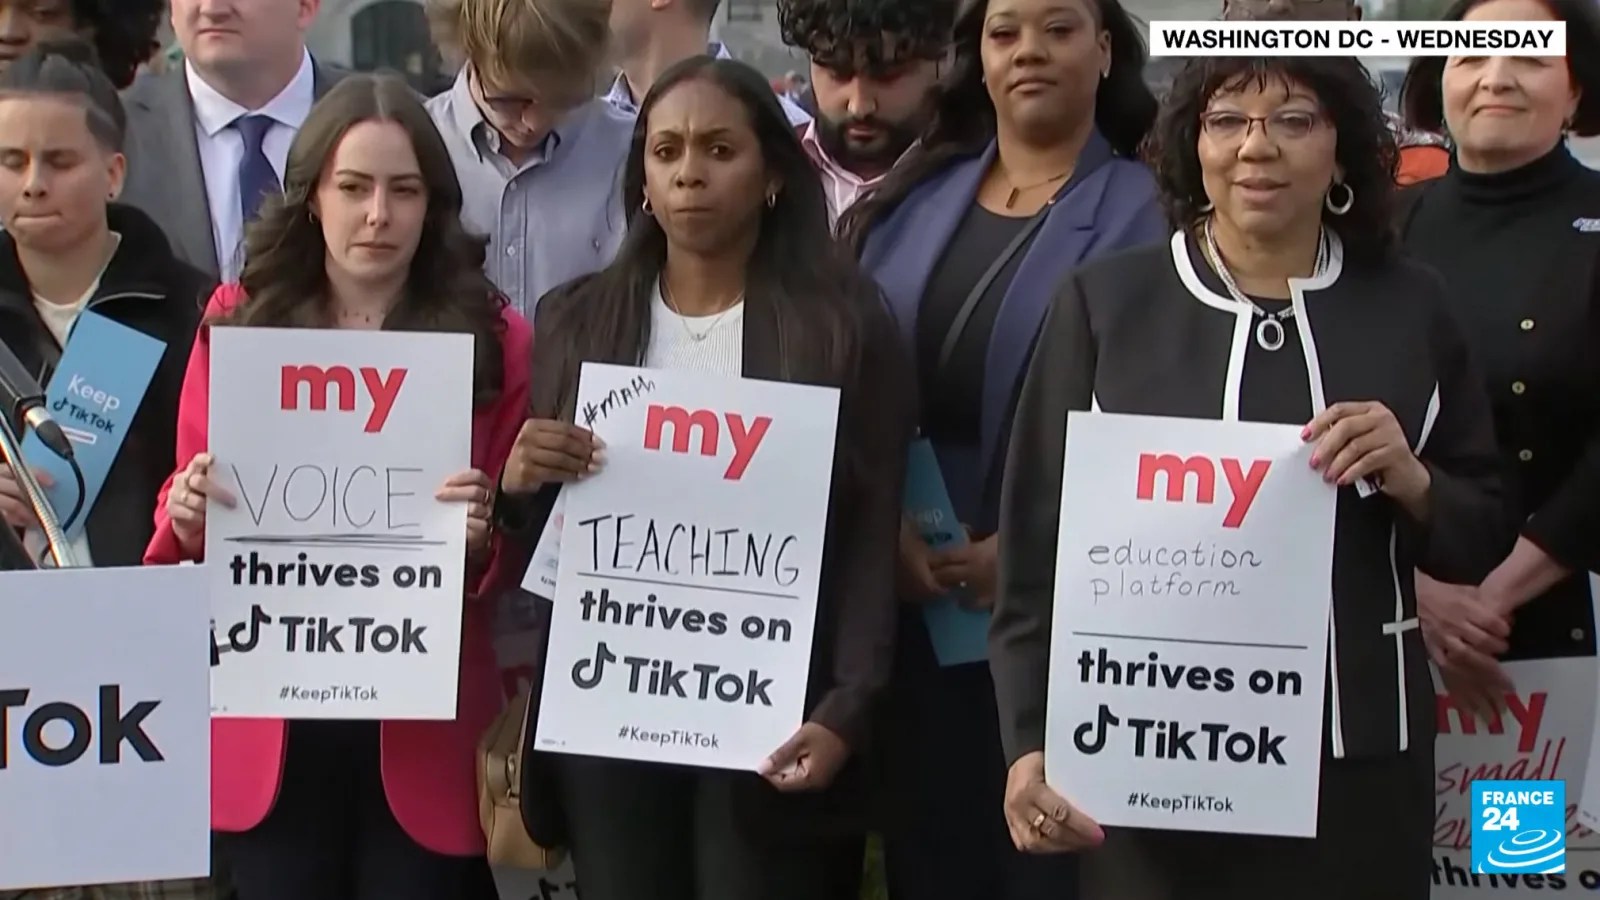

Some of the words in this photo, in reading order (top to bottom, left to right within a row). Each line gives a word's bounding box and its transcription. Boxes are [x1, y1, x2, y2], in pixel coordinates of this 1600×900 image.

[67, 373, 121, 413] Keep
[280, 364, 408, 433] my
[68, 402, 116, 435] TikTok
[643, 404, 771, 481] my
[229, 462, 425, 529] VOICE
[1135, 451, 1272, 529] my
[229, 552, 381, 588] thrives
[392, 565, 443, 588] on
[577, 512, 800, 586] TEACHING
[1088, 538, 1263, 569] education
[1089, 569, 1241, 604] platform
[279, 616, 429, 654] TikTok
[579, 588, 728, 635] thrives
[740, 615, 793, 642] on
[623, 655, 774, 706] TikTok
[1077, 647, 1235, 693] thrives
[1248, 669, 1303, 696] on
[279, 685, 379, 704] #KeepTikTok
[617, 725, 720, 750] #KeepTikTok
[1126, 717, 1288, 767] TikTok
[1127, 791, 1235, 815] #KeepTikTok
